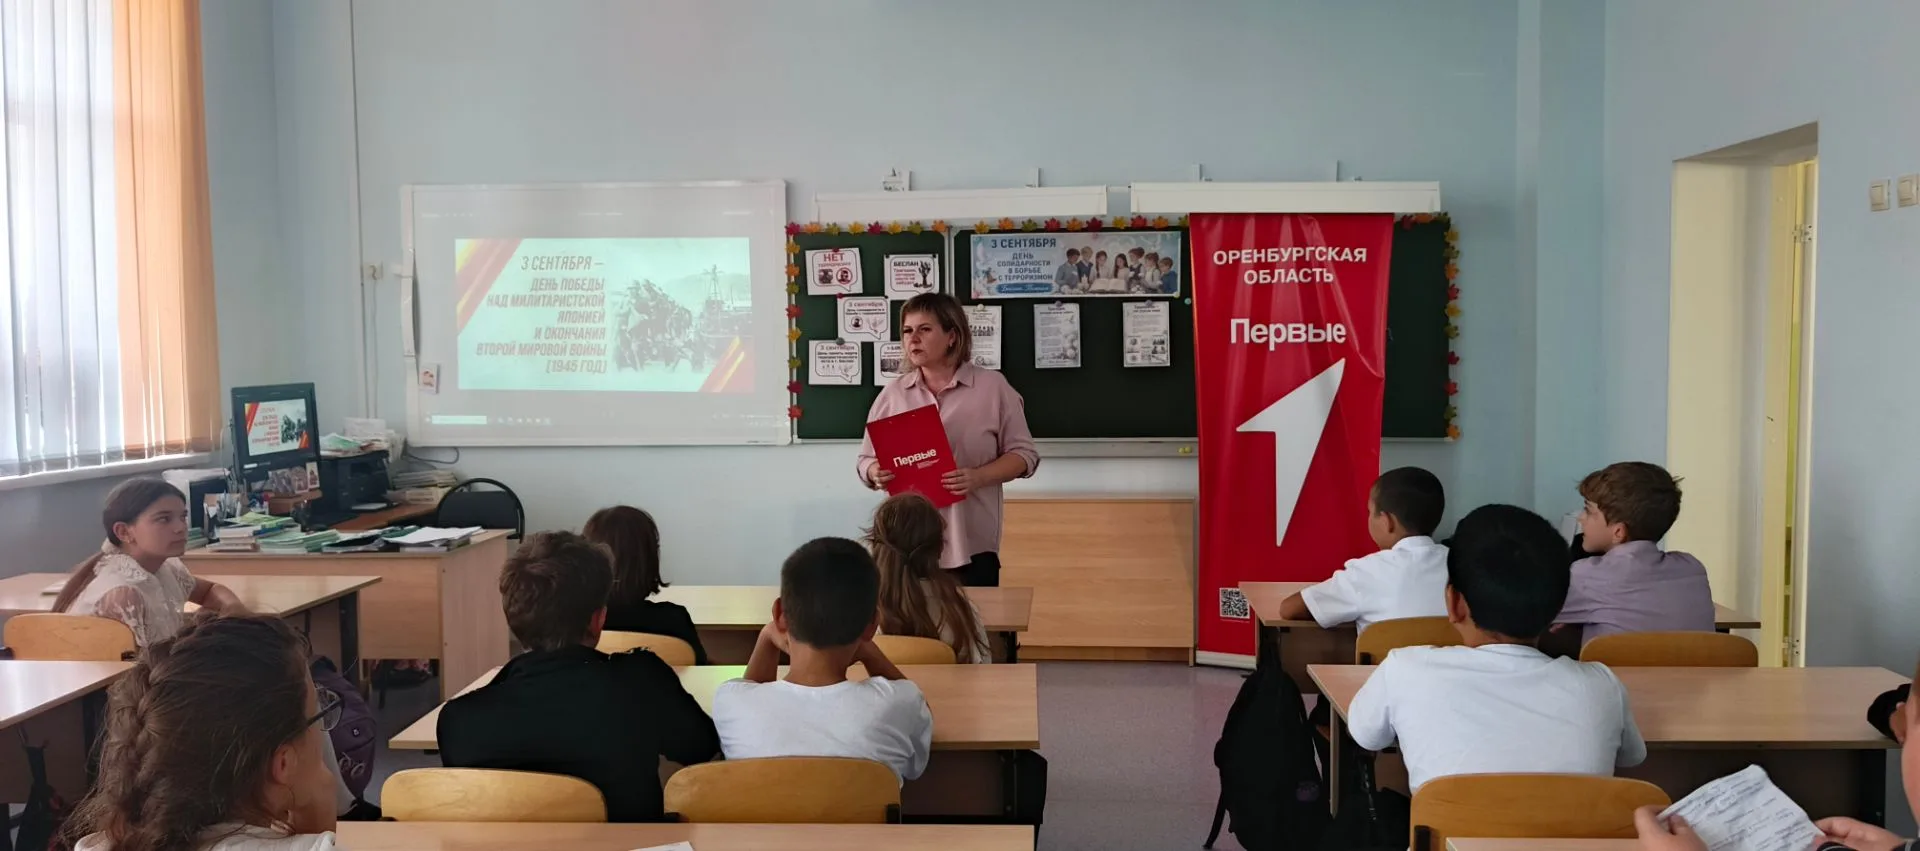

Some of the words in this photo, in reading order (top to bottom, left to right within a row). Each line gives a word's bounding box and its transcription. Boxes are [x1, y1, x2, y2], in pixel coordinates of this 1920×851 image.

[991, 239, 997, 248] 3
[1000, 238, 1057, 248] СЕНТЯБРЯ
[823, 252, 845, 262] НЕТ
[1012, 252, 1034, 260] ДЕНЬ
[1213, 246, 1367, 265] ОРЕНБУРГСКАЯ
[521, 256, 529, 270] 3
[531, 256, 592, 271] СЕНТЯБРЯ
[1243, 268, 1334, 285] ОБЛАСТЬ
[529, 278, 558, 292] ДЕНЬ
[560, 278, 605, 291] ПОБЕДЫ
[486, 294, 508, 308] НАД
[510, 294, 605, 308] МИЛИТАРИСТСКОЙ
[556, 310, 605, 324] ЯПОНИЕЙ
[534, 327, 542, 339] И
[544, 327, 606, 340] ОКОНЧАНИЯ
[1230, 318, 1347, 351] Первые
[476, 342, 516, 356] ВТОРОЙ
[518, 342, 567, 356] МИРОВОЙ
[568, 342, 607, 356] ВОЙНЫ
[893, 448, 937, 467] Первые
